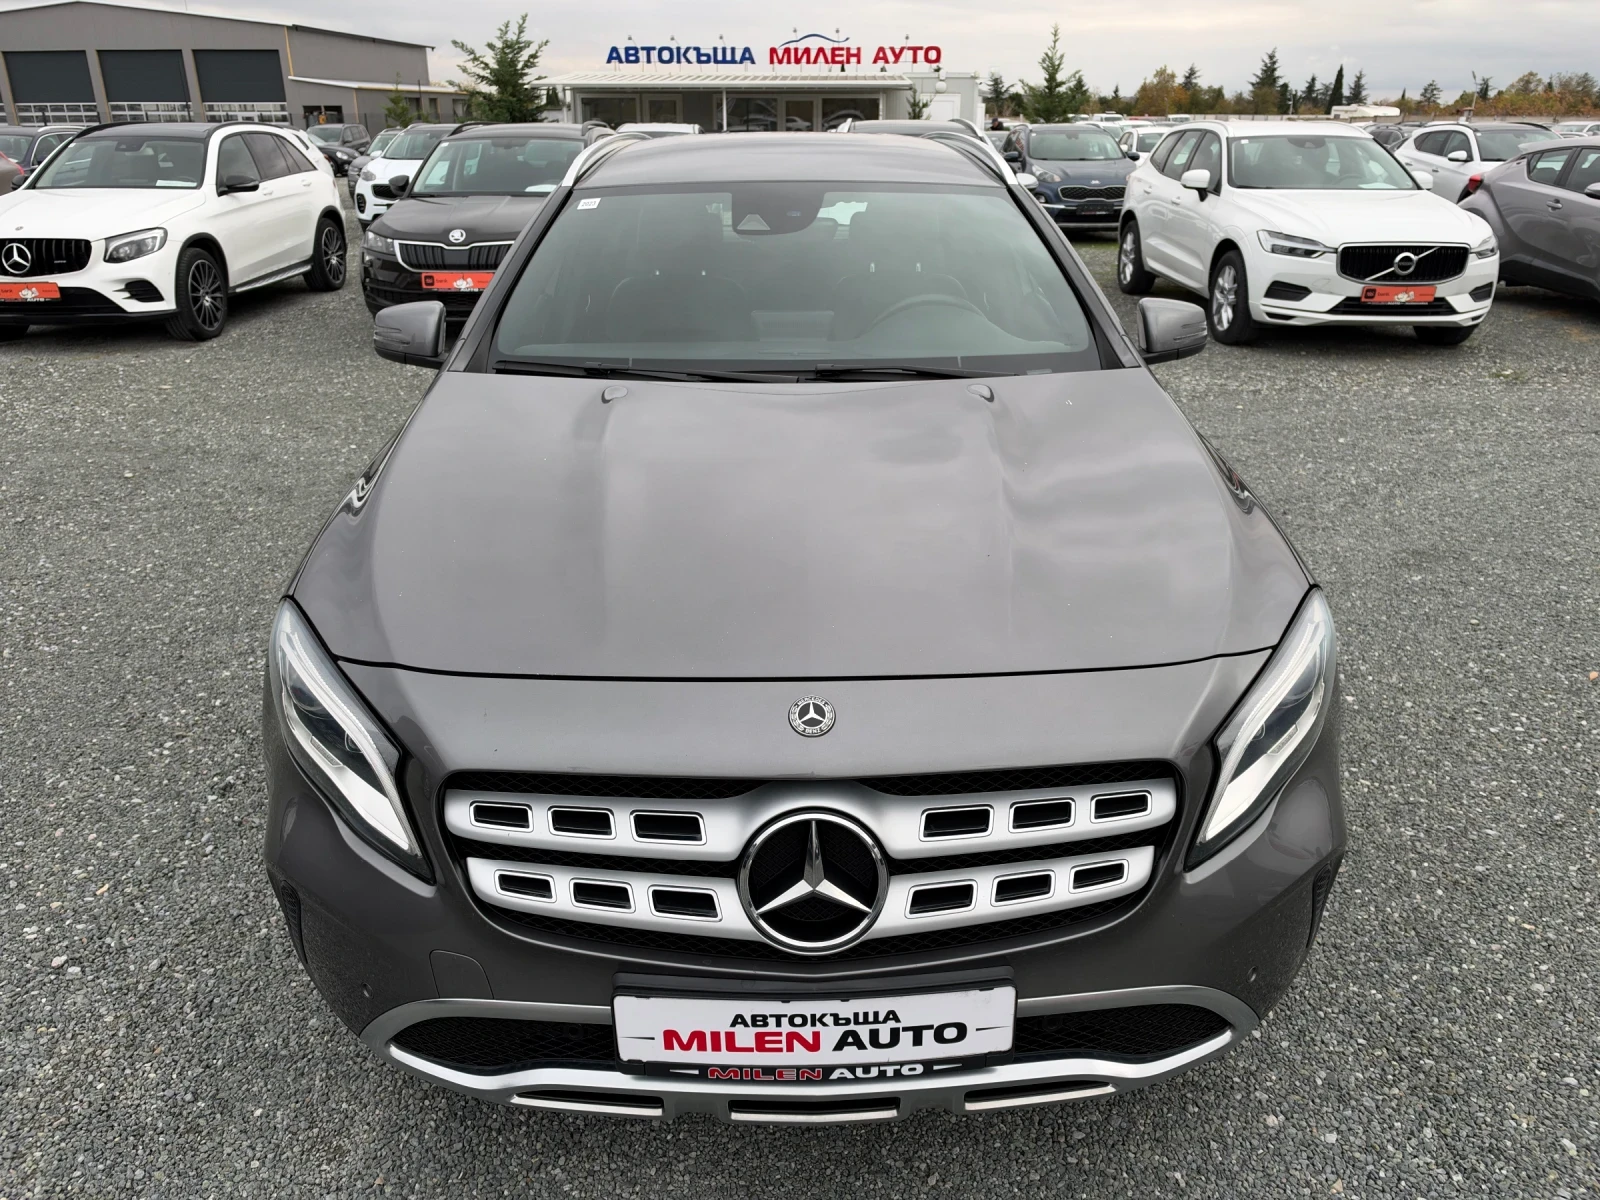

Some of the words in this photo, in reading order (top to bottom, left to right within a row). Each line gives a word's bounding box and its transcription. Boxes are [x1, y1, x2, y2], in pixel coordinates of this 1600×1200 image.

[606, 46, 756, 65] АВТОКЪЩА
[769, 47, 861, 65] МИЛЕН
[872, 46, 942, 64] АУТО
[729, 1009, 902, 1028] АВТОКЪЩА
[663, 1029, 821, 1053] MILEN
[832, 1022, 967, 1052] AUTO
[708, 1067, 822, 1081] MILEN
[829, 1063, 924, 1080] AUTO
